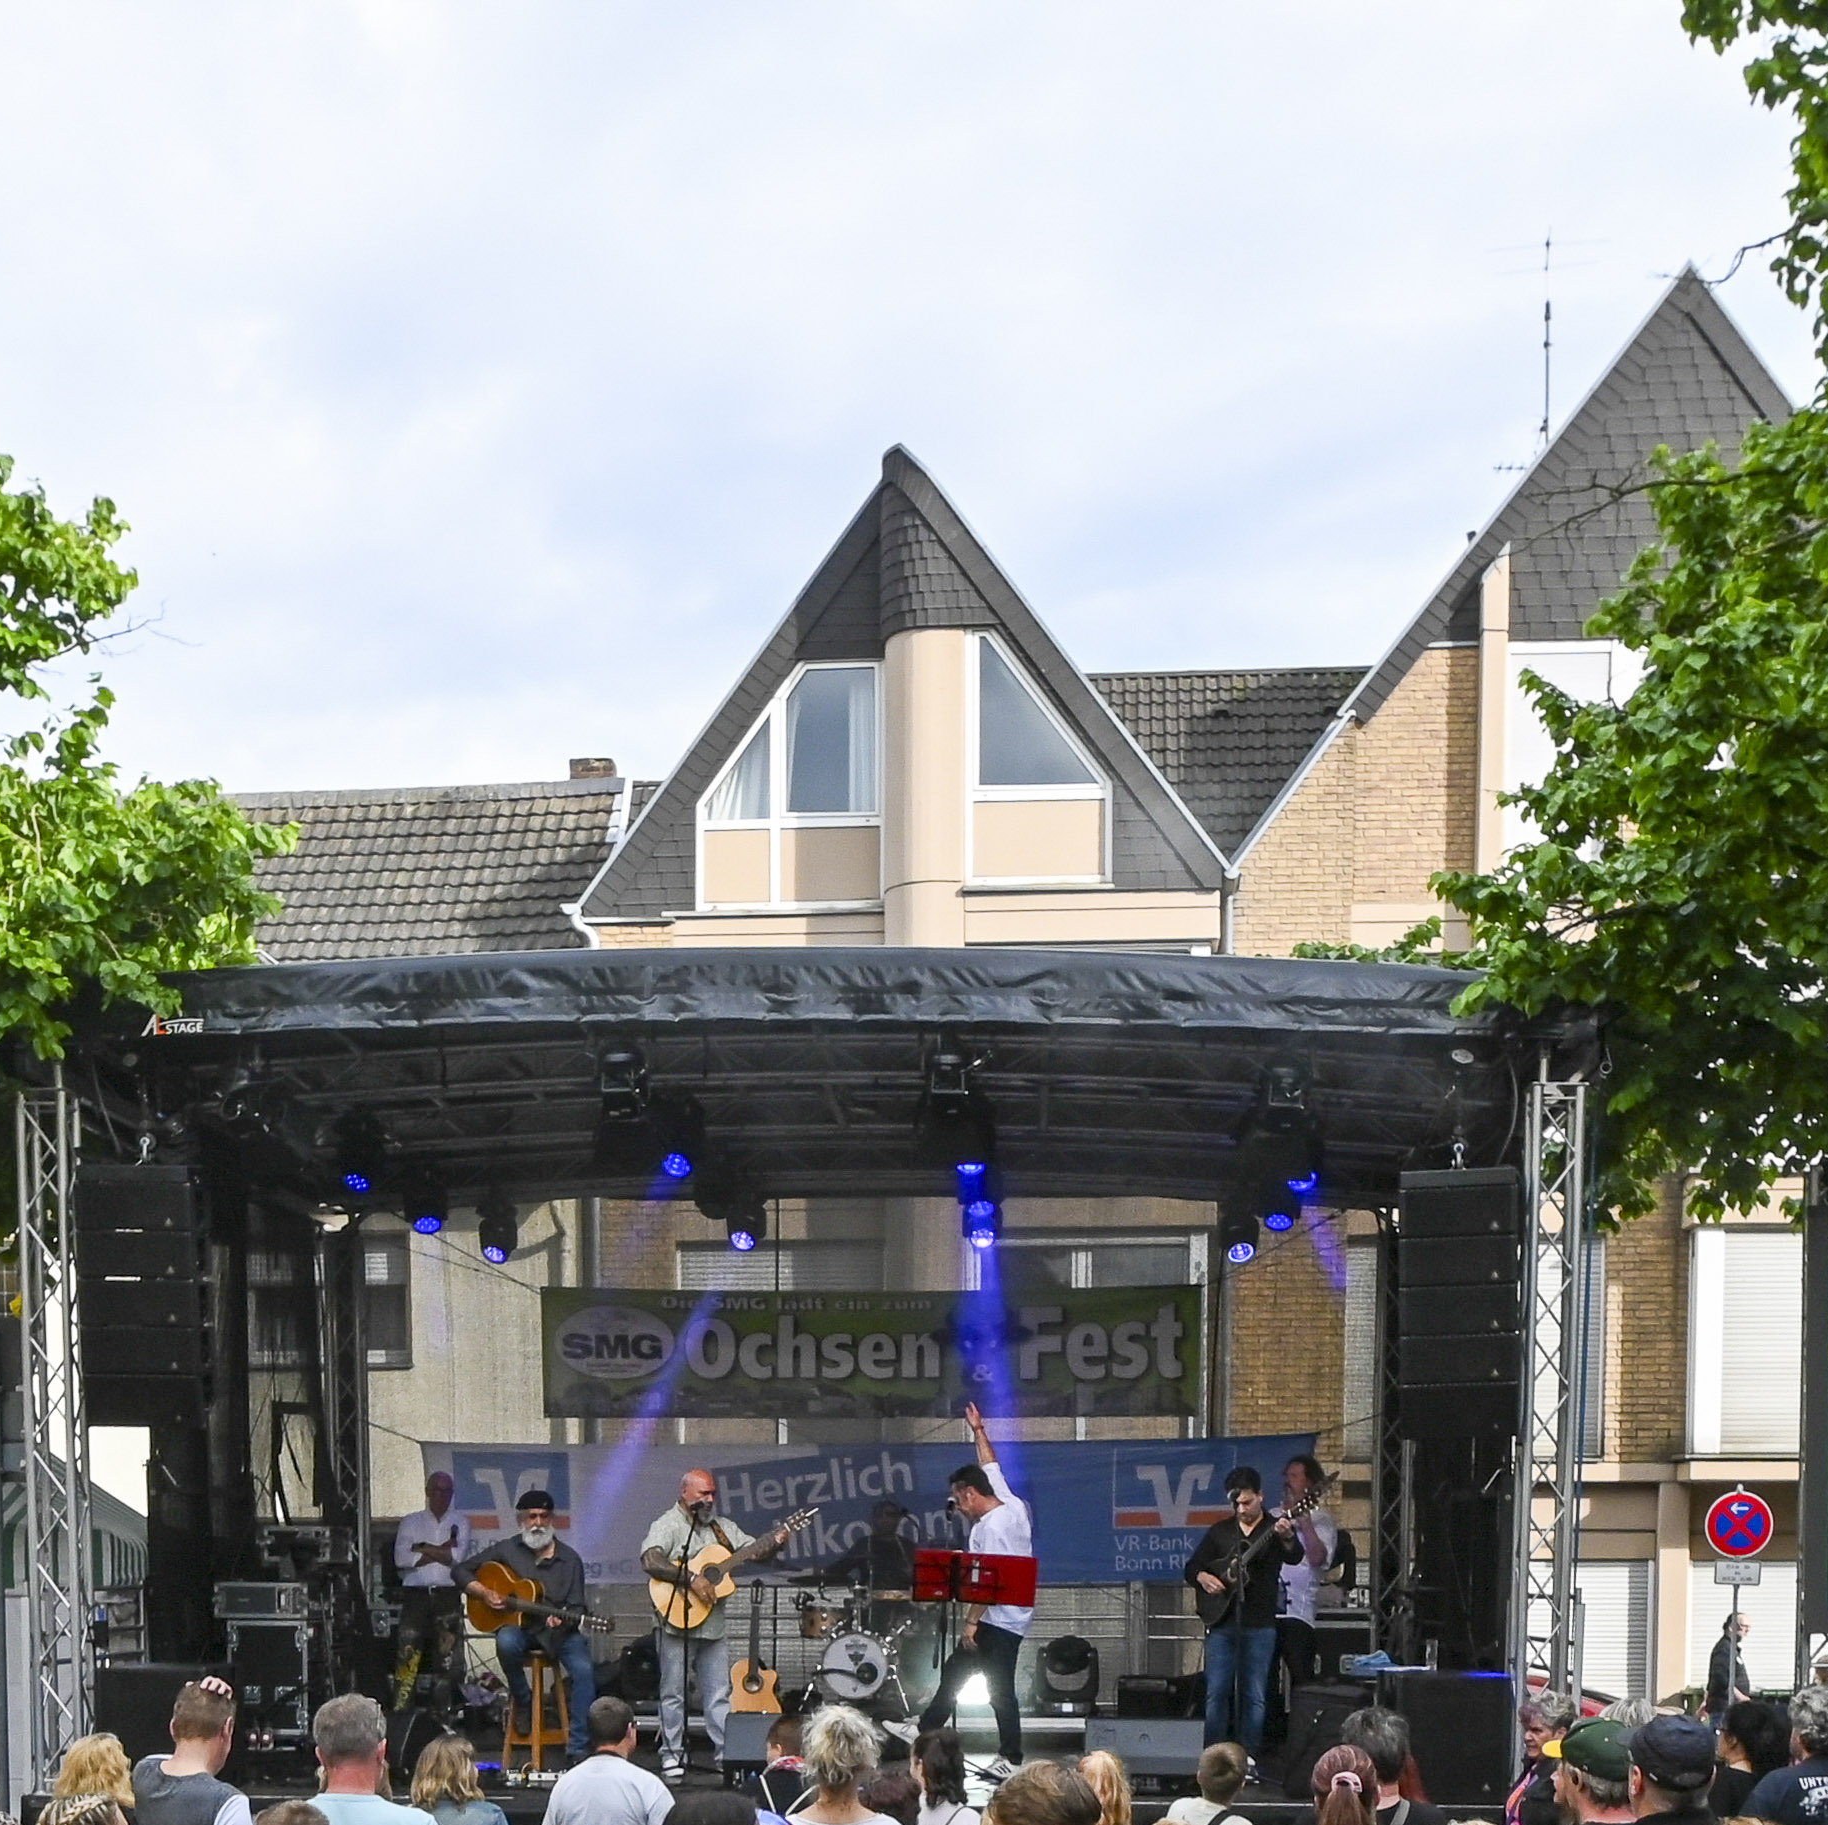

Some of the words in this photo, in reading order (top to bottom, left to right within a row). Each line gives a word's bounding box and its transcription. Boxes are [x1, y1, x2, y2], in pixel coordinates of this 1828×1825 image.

[711, 1295, 767, 1311] SMG
[562, 1332, 664, 1360] SMG
[685, 1313, 940, 1380] Ochsen
[972, 1363, 996, 1382] &
[1020, 1303, 1184, 1380] Fest
[716, 1451, 914, 1515] Herzlich
[1114, 1534, 1194, 1552] VR-Bank
[1115, 1555, 1163, 1571] Bonn
